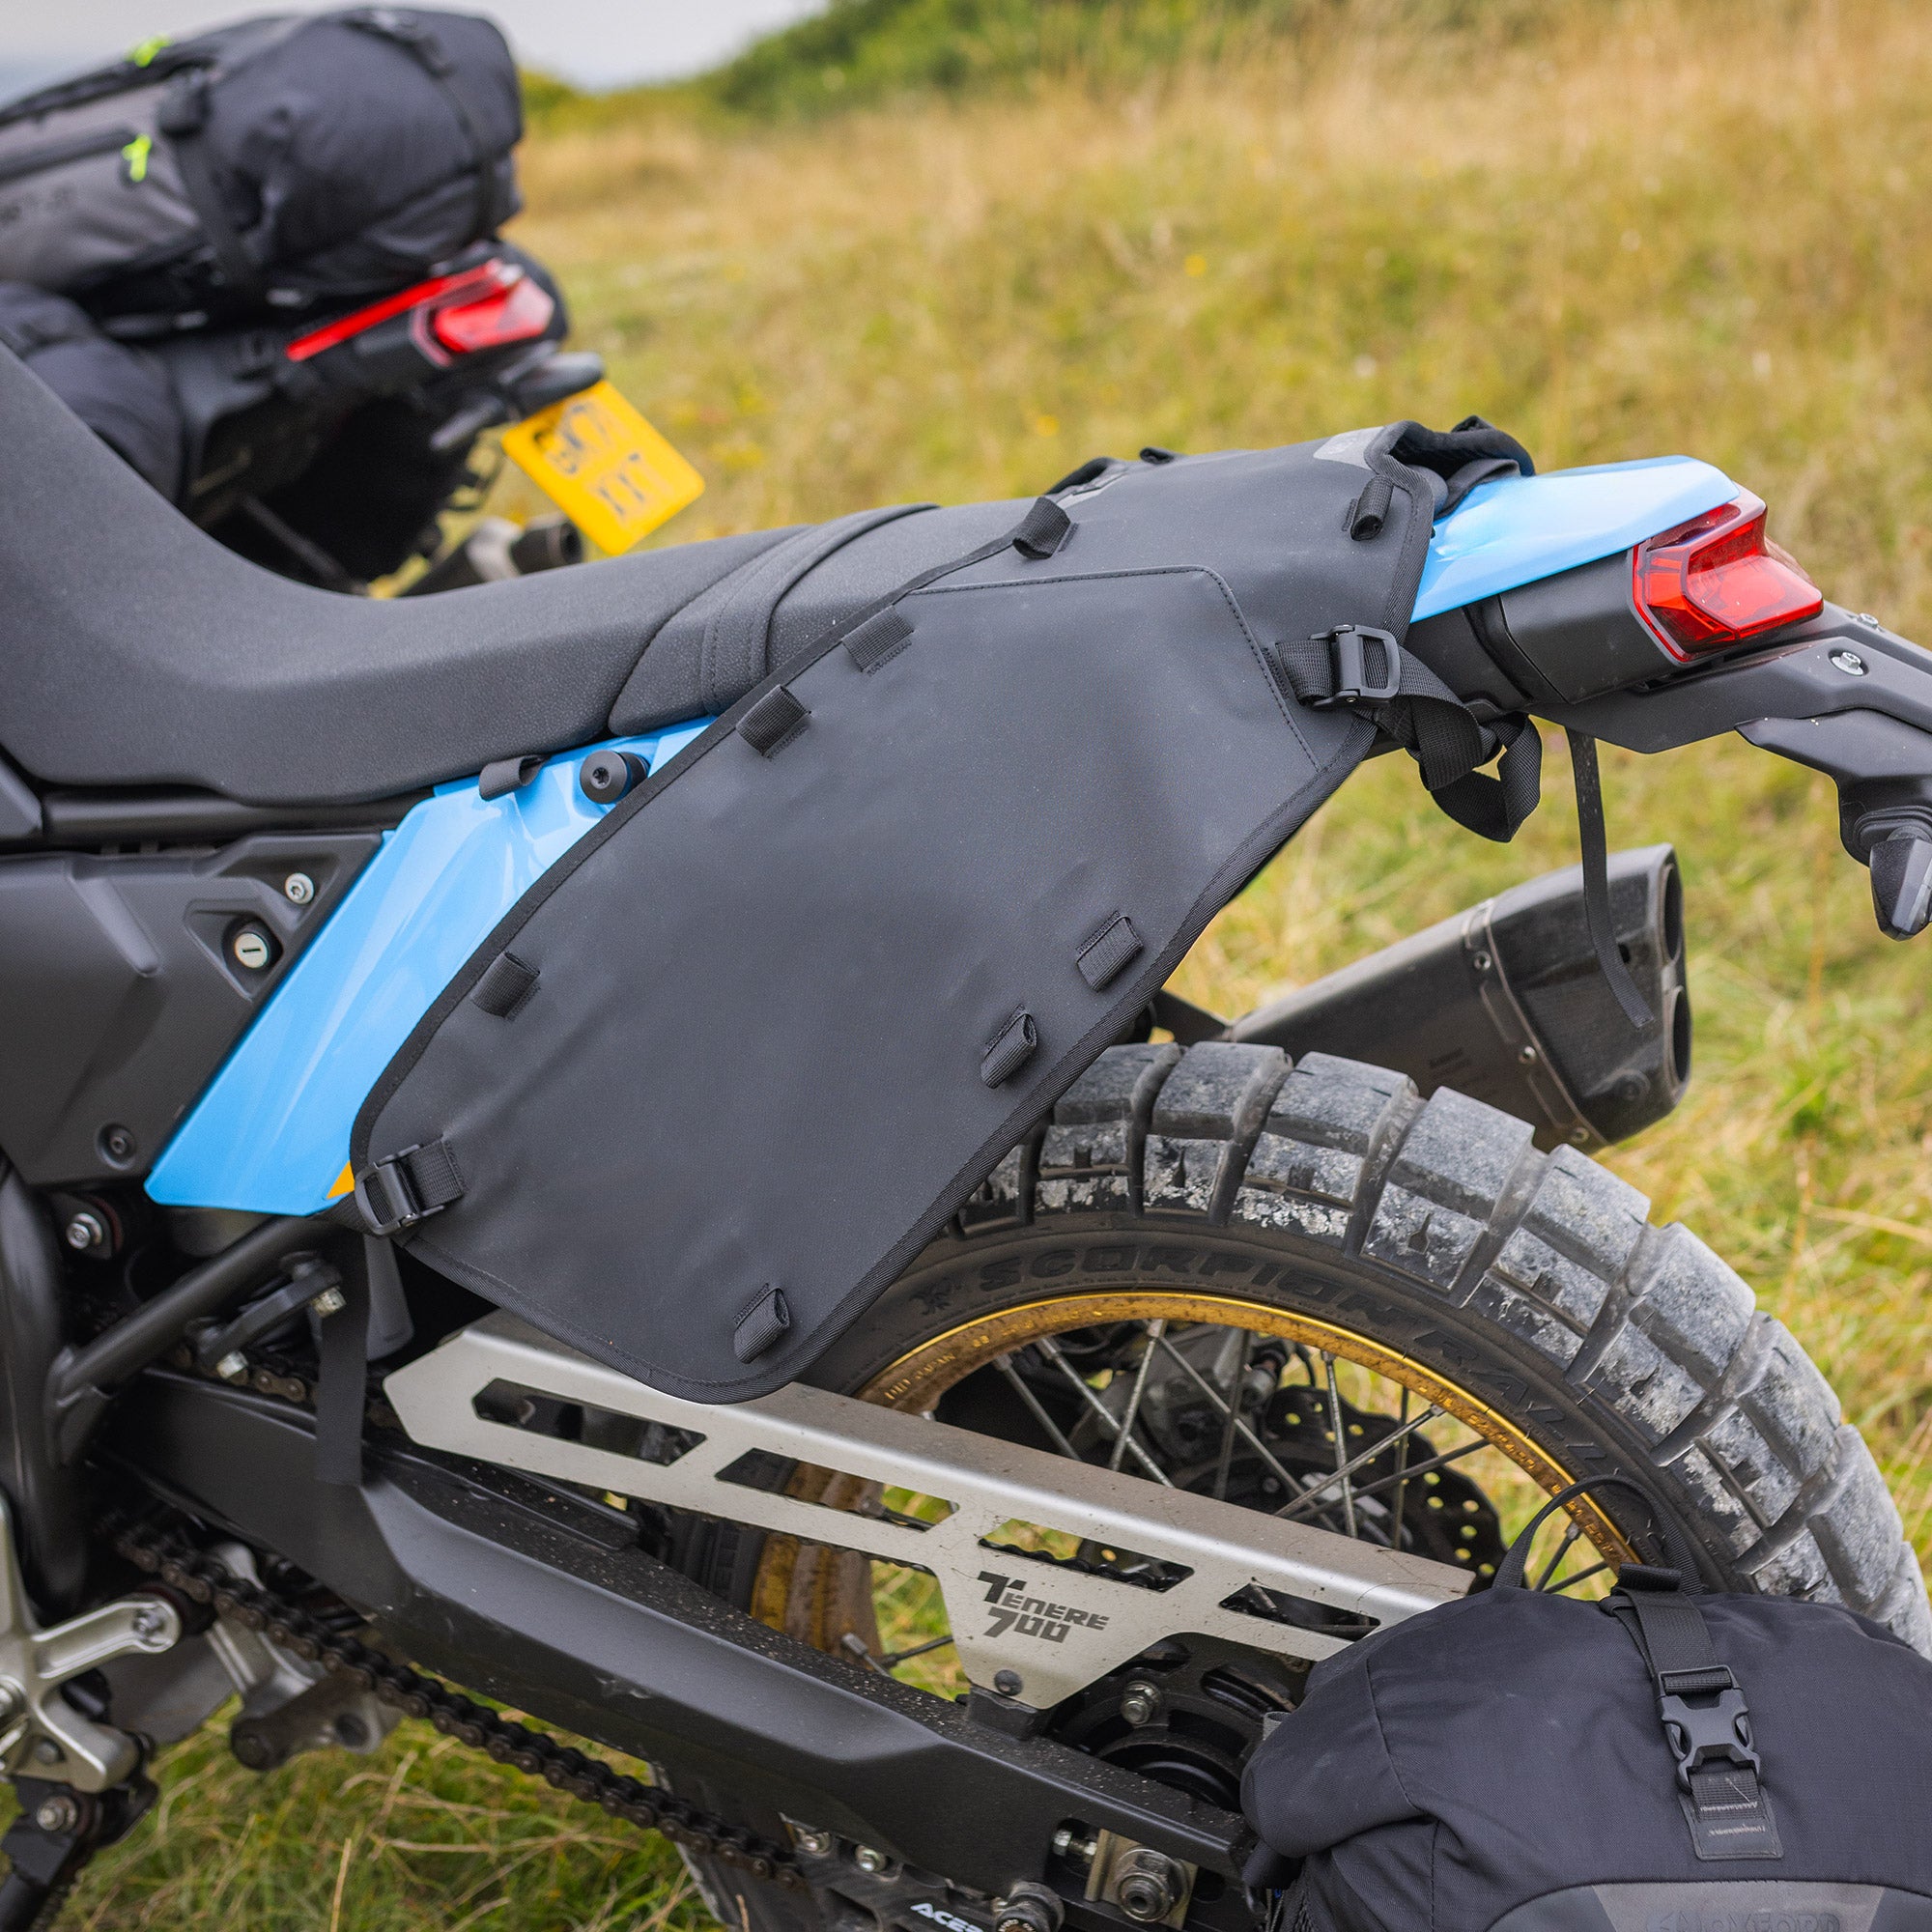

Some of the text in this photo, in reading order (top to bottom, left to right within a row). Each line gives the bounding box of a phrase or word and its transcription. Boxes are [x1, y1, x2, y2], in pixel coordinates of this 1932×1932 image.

[976, 1244, 1410, 1329] SCORPION
[1412, 1327, 1623, 1483] RALL
[982, 1606, 1071, 1643] 700
